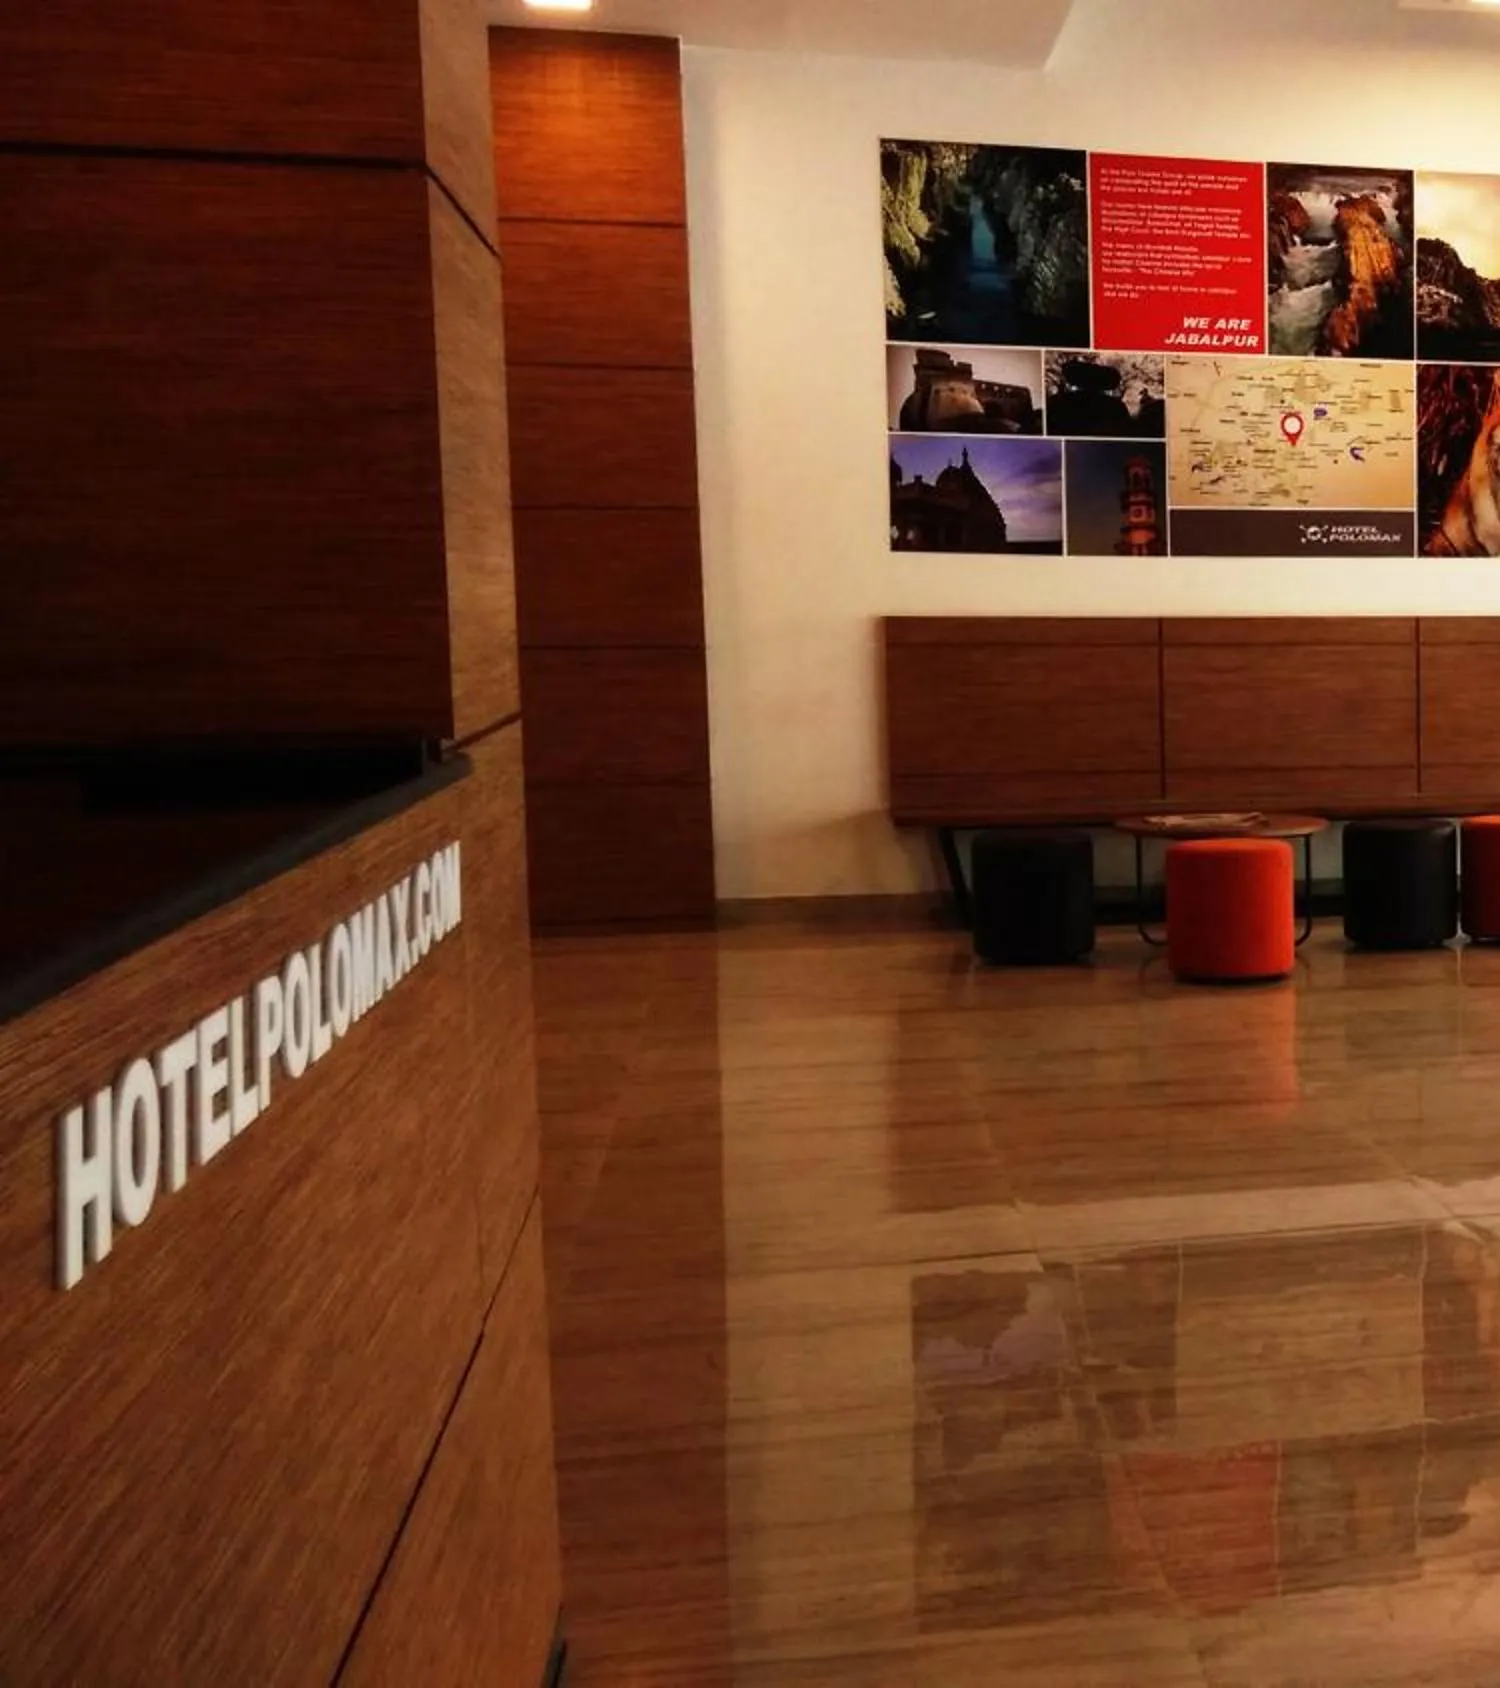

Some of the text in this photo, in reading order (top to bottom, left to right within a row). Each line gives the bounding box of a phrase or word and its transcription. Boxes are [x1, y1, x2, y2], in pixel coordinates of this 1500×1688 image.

[1183, 316, 1252, 331] WE ARE
[1164, 333, 1259, 347] JABALPUR
